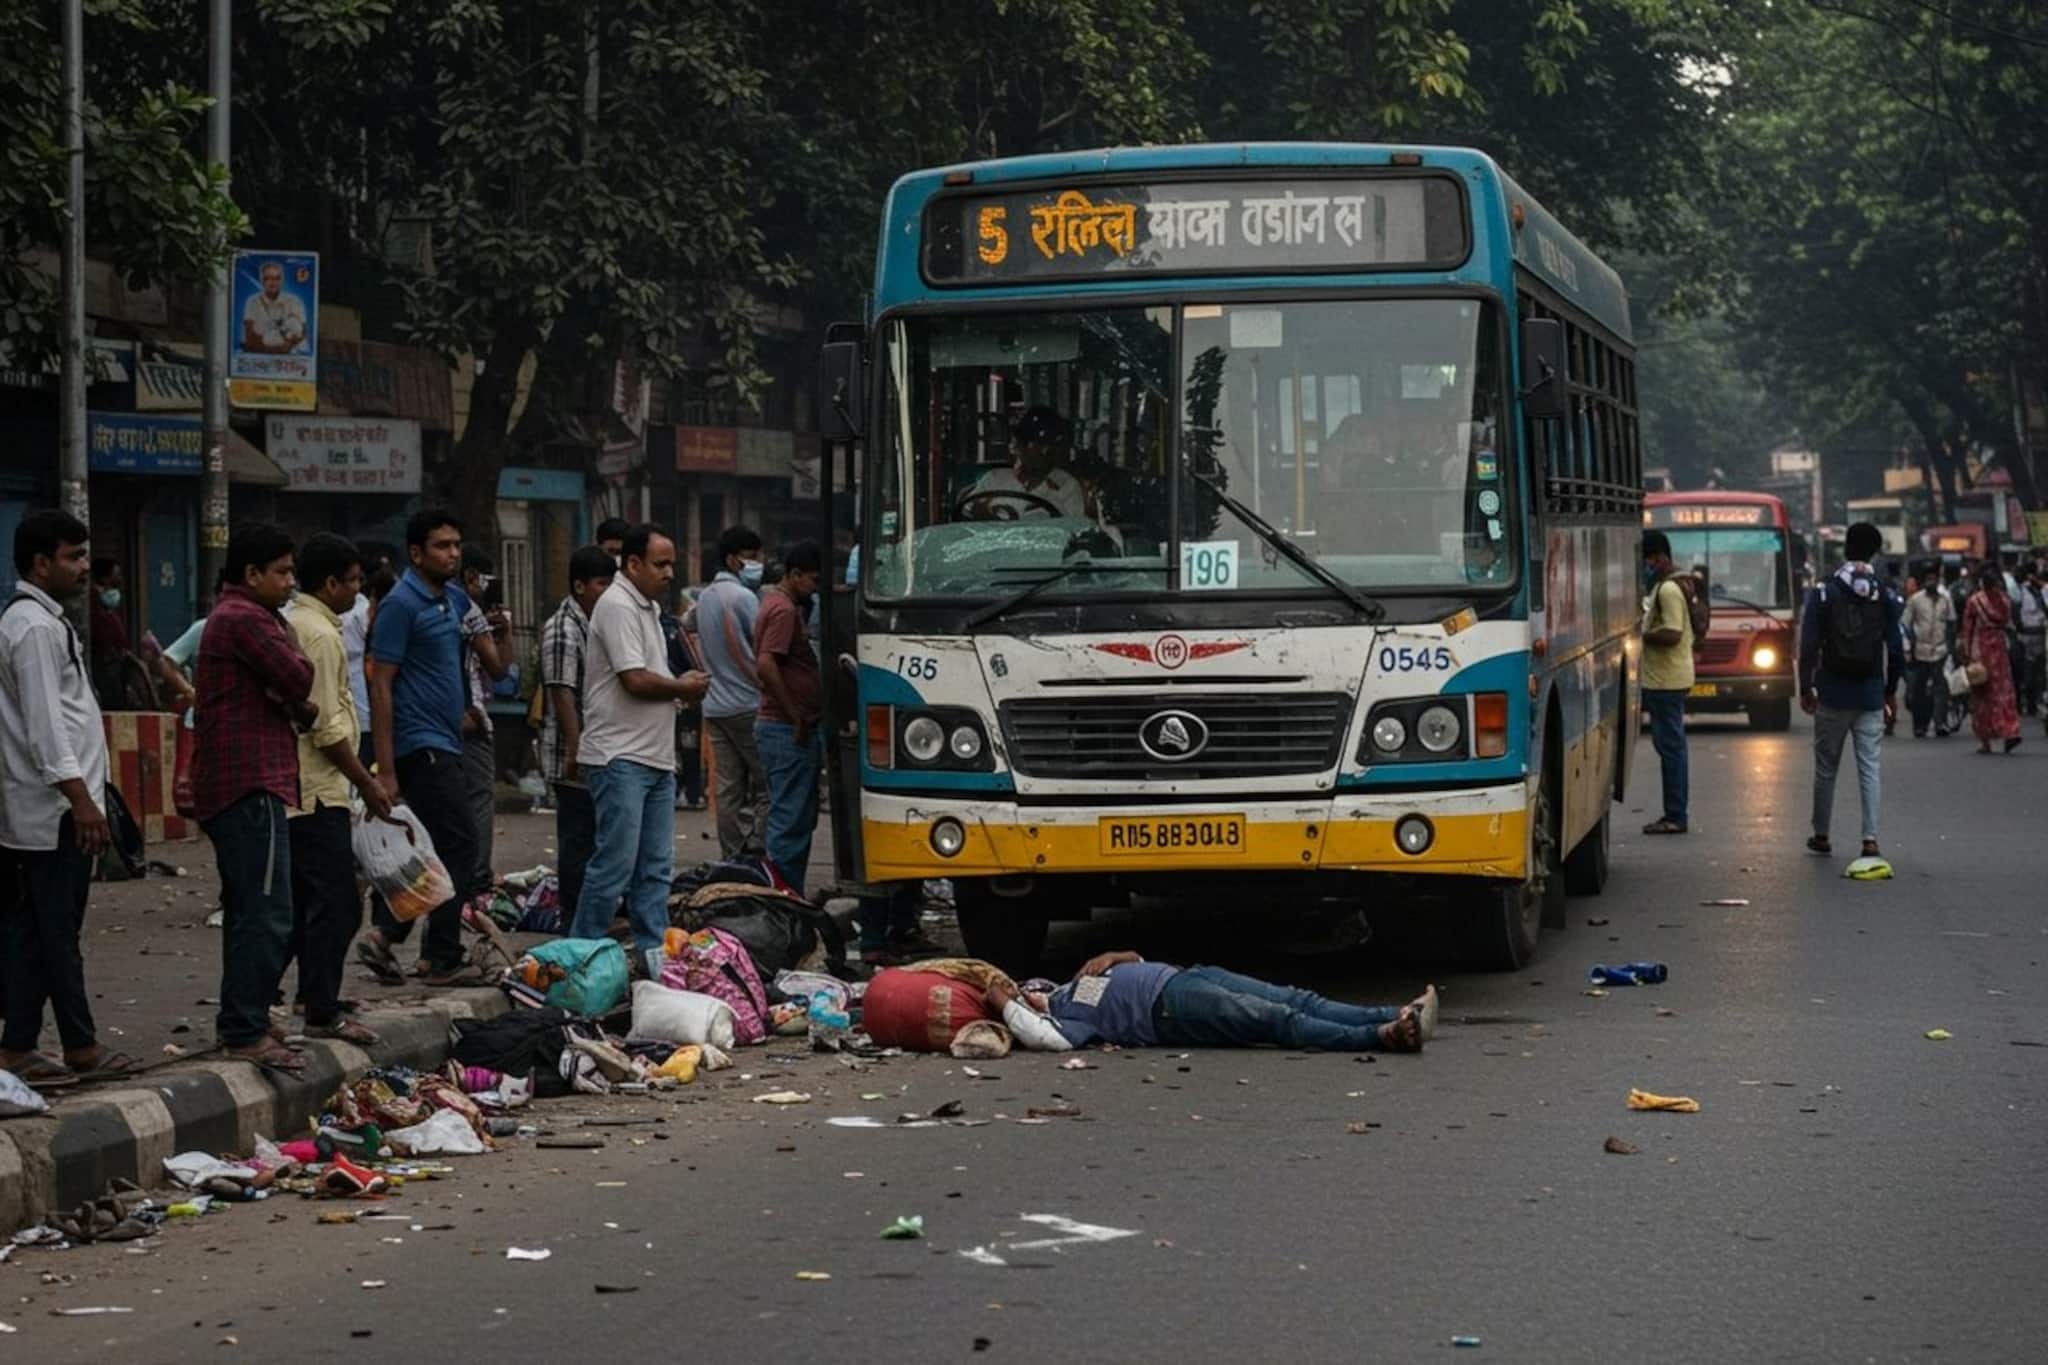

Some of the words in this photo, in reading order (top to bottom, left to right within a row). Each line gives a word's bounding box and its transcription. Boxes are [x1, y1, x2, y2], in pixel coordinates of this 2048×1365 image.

[979, 207, 1007, 264] 5
[1184, 547, 1230, 586] 196
[1380, 647, 1450, 672] 0545
